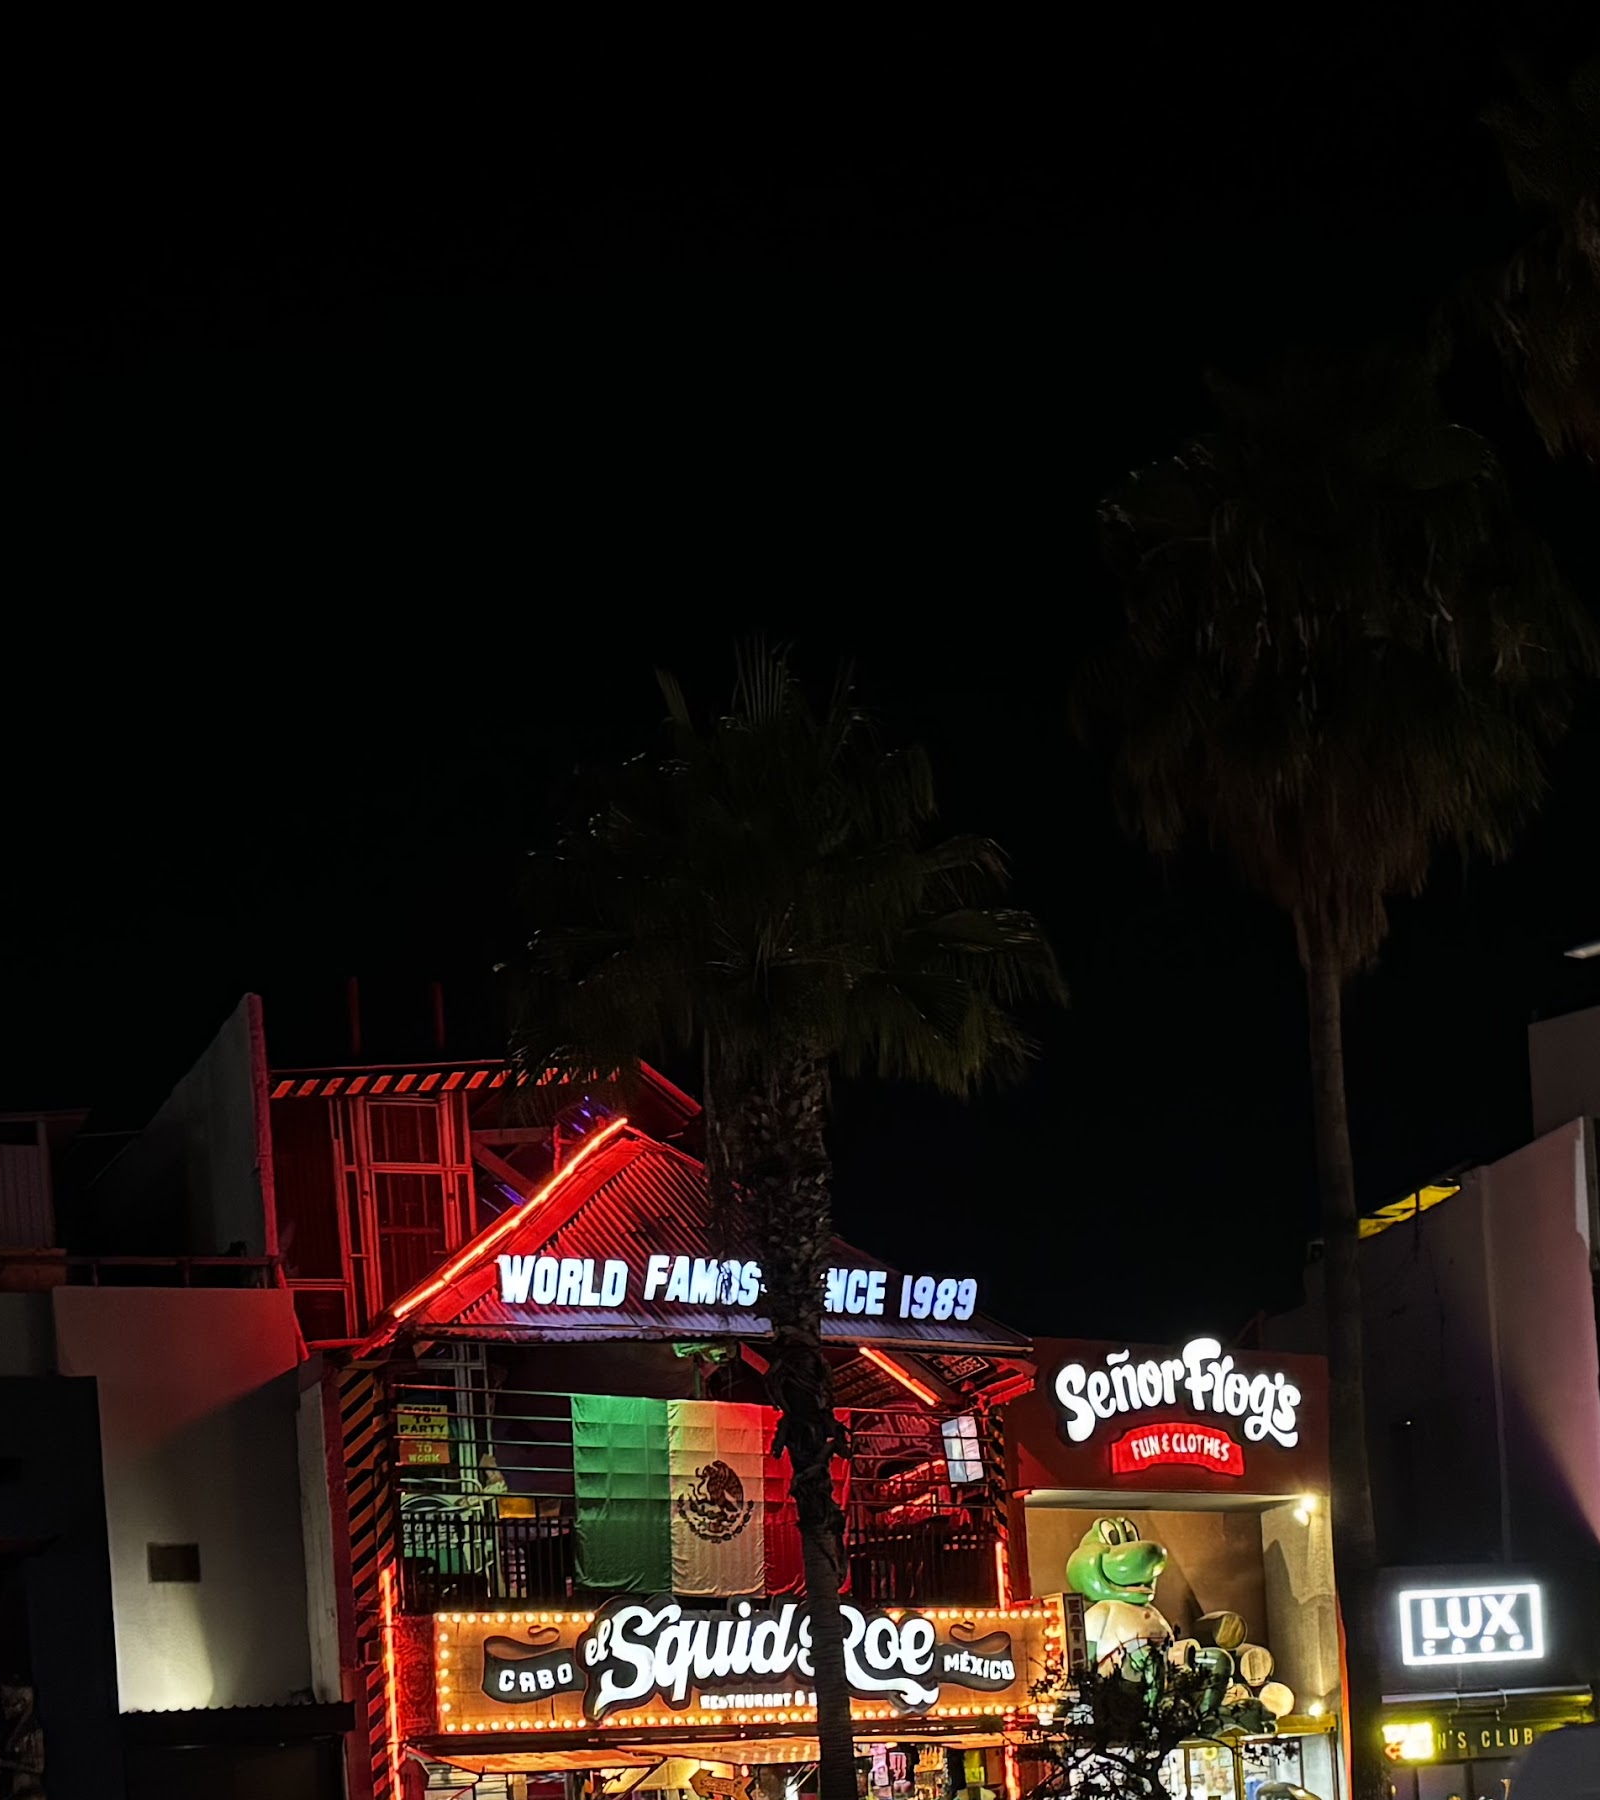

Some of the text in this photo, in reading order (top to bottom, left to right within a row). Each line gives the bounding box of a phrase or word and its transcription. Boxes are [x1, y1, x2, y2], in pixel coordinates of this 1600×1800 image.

[496, 1254, 629, 1307] WORLD
[821, 1268, 887, 1315] NCE
[900, 1275, 978, 1321] 1989
[1055, 1338, 1301, 1447] Señor Frog's
[400, 1424, 445, 1433] PARTY
[416, 1444, 432, 1454] TO
[1131, 1434, 1160, 1461] FUN
[1172, 1432, 1231, 1462] CLOTHES
[1421, 1594, 1520, 1640] LUX
[585, 1618, 612, 1667] el
[594, 1601, 799, 1716] Squid
[944, 1651, 1016, 1680] MÉXICO
[499, 1663, 573, 1693] CABO
[700, 1694, 792, 1709] RESTAURANT
[1437, 1728, 1533, 1750] N'S CLUB
